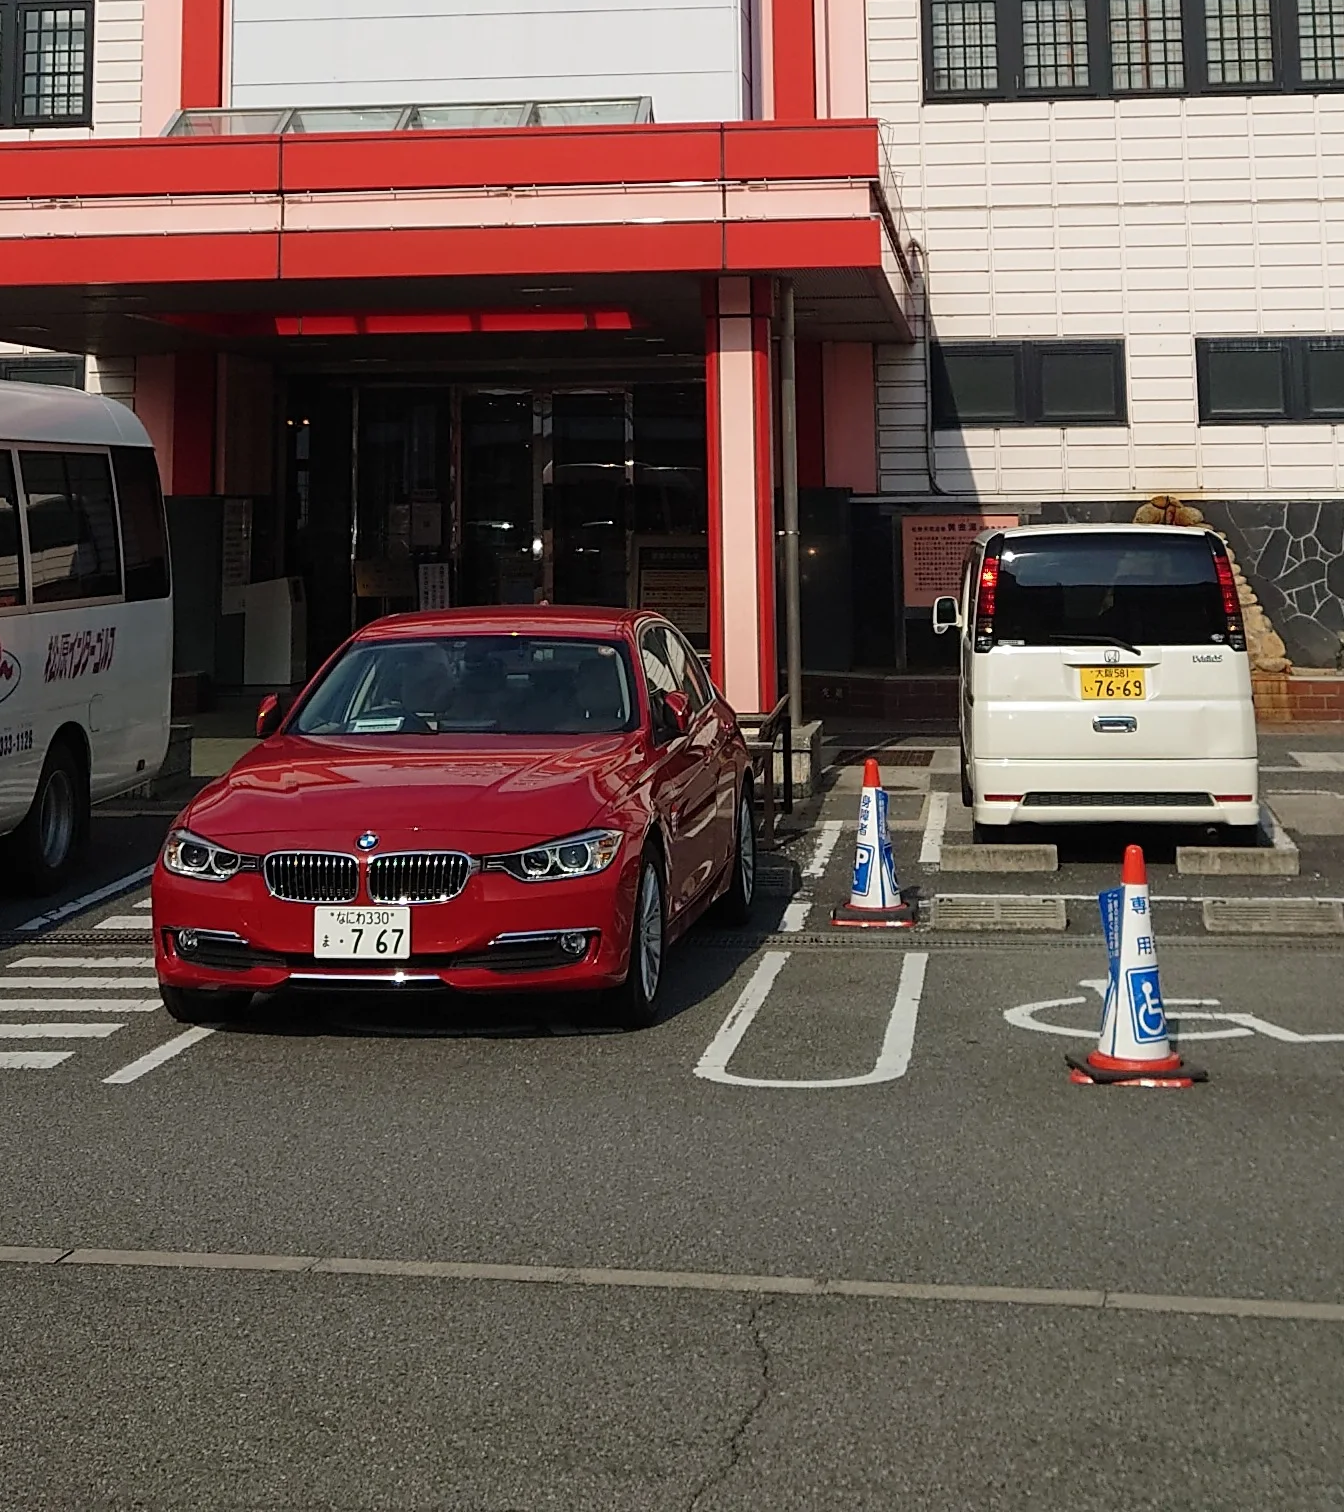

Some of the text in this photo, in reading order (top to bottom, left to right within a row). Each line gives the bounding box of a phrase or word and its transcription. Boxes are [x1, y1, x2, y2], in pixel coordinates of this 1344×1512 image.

[1094, 680, 1142, 697] 76-69
[855, 848, 869, 870] P
[336, 911, 390, 925] なにわ330
[322, 934, 330, 948] ま
